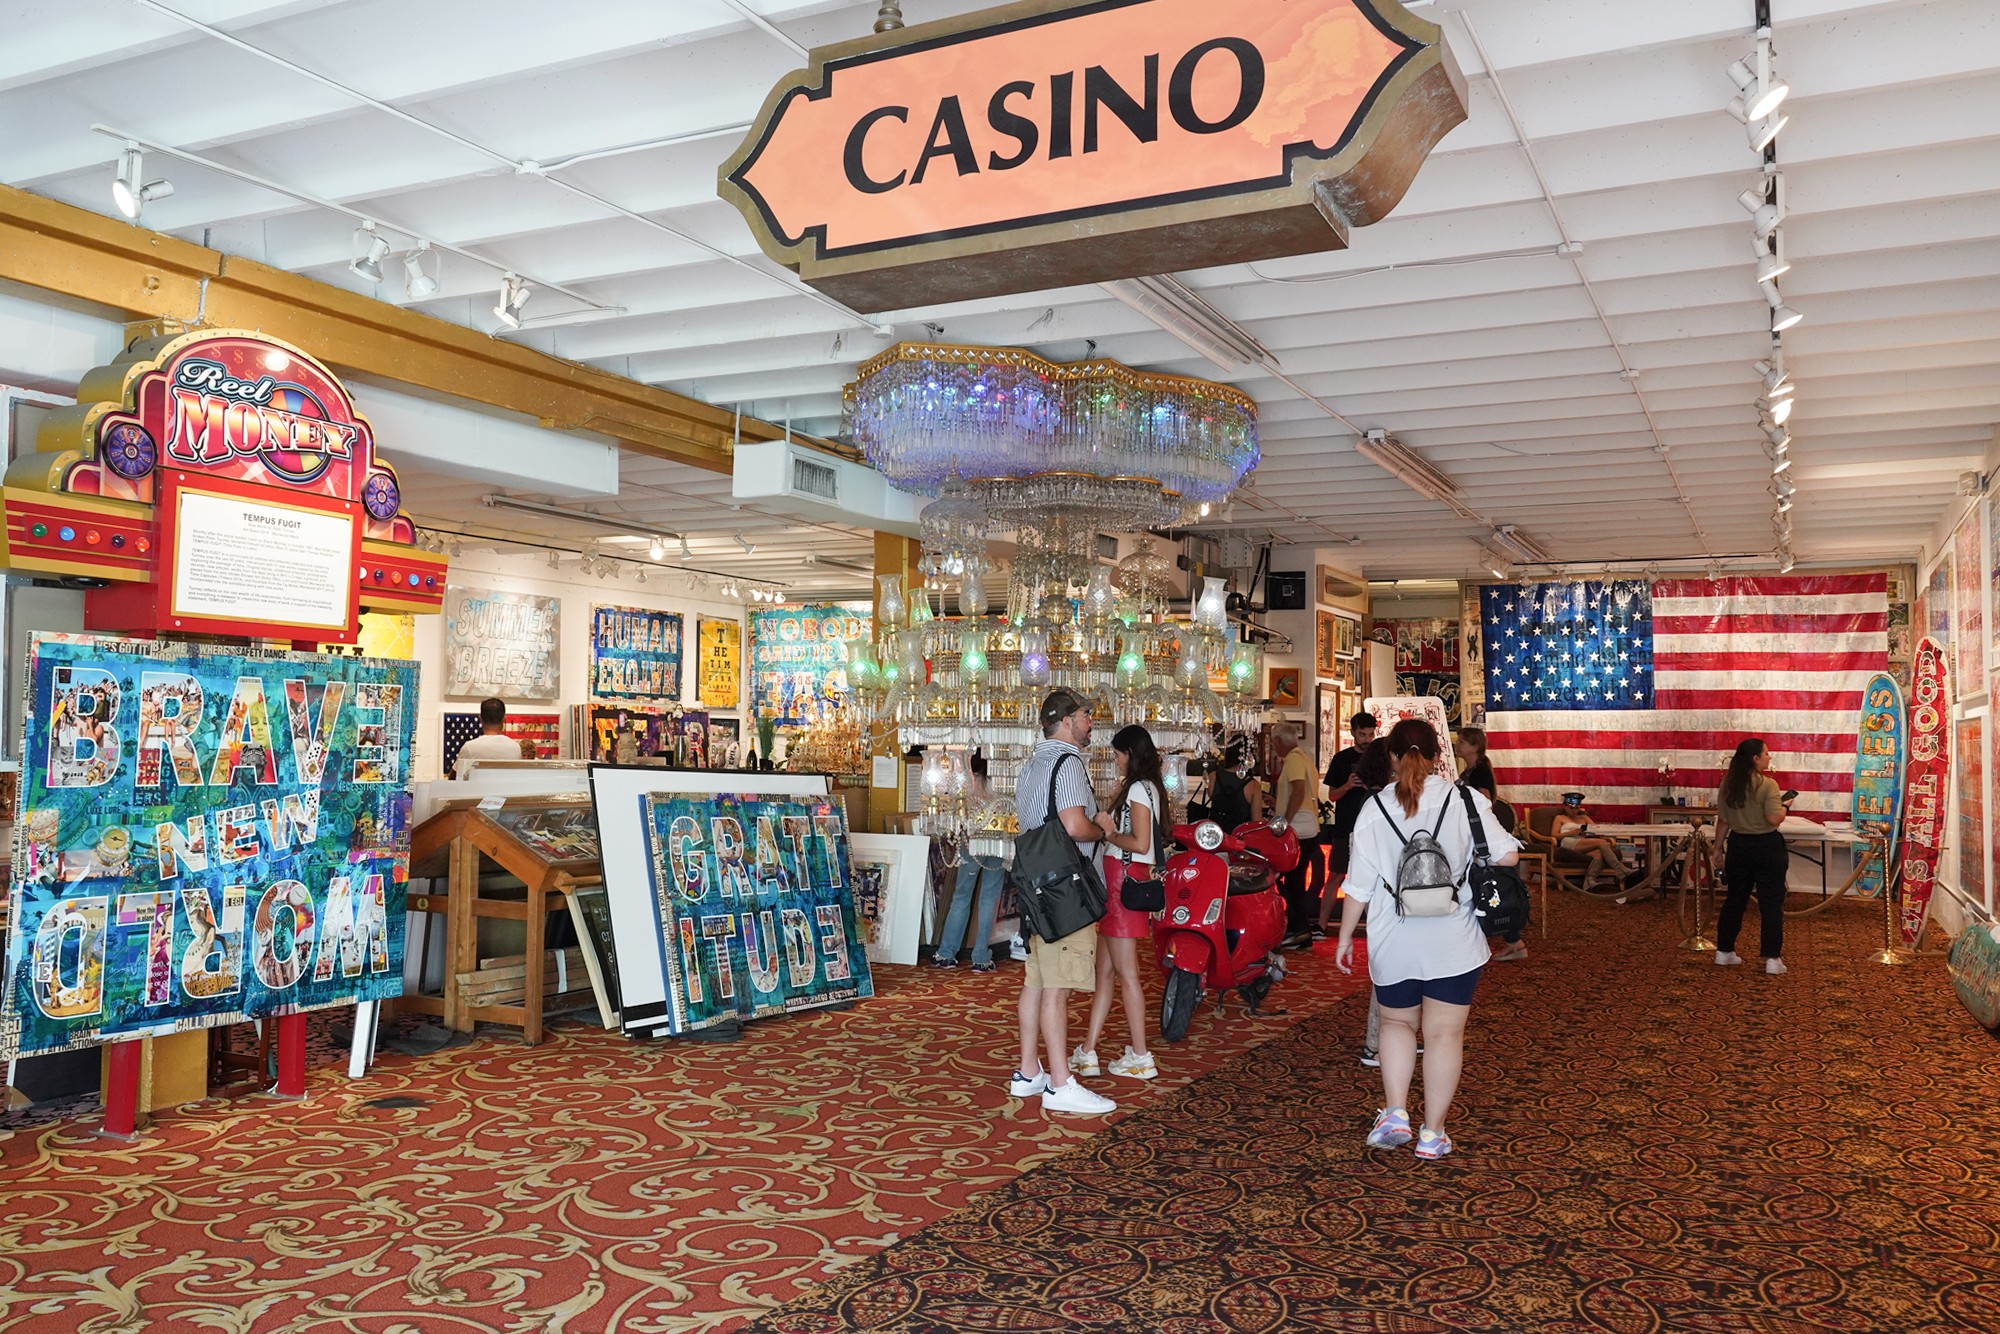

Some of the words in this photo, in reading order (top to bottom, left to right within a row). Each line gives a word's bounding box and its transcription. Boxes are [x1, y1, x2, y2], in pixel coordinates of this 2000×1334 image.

[842, 37, 1265, 193] CASINO
[180, 362, 274, 401] Reel
[172, 387, 354, 461] MONEY
[243, 513, 276, 526] TEMPUS
[278, 519, 301, 529] FUGIT
[456, 598, 555, 643] SUMMER
[598, 613, 678, 653] HUMAN
[717, 629, 725, 643] T
[119, 643, 137, 653] GOT
[138, 644, 149, 655] IT
[152, 642, 166, 652] BY
[169, 642, 187, 653] THE
[238, 648, 262, 657] SAFETY
[264, 649, 287, 659] DANCE
[457, 645, 549, 686] BREEZE
[710, 659, 730, 669] TIM
[714, 646, 727, 657] HE
[759, 645, 806, 661] SAID
[813, 646, 832, 661] IT
[598, 657, 678, 695] NATURE
[1910, 650, 1939, 762] GOOD
[45, 667, 403, 788] BRAVE
[86, 806, 102, 814] LUXE
[1906, 774, 1937, 848] ALL
[156, 789, 320, 880] NEW
[33, 874, 389, 1019] WORLD
[679, 904, 851, 1004] ITUDE
[69, 1030, 91, 1039] BRAIN
[175, 1017, 201, 1032] CALL
[201, 1015, 215, 1028] TO
[216, 1012, 243, 1026] MIND
[48, 1039, 94, 1053] ATTRACTION
